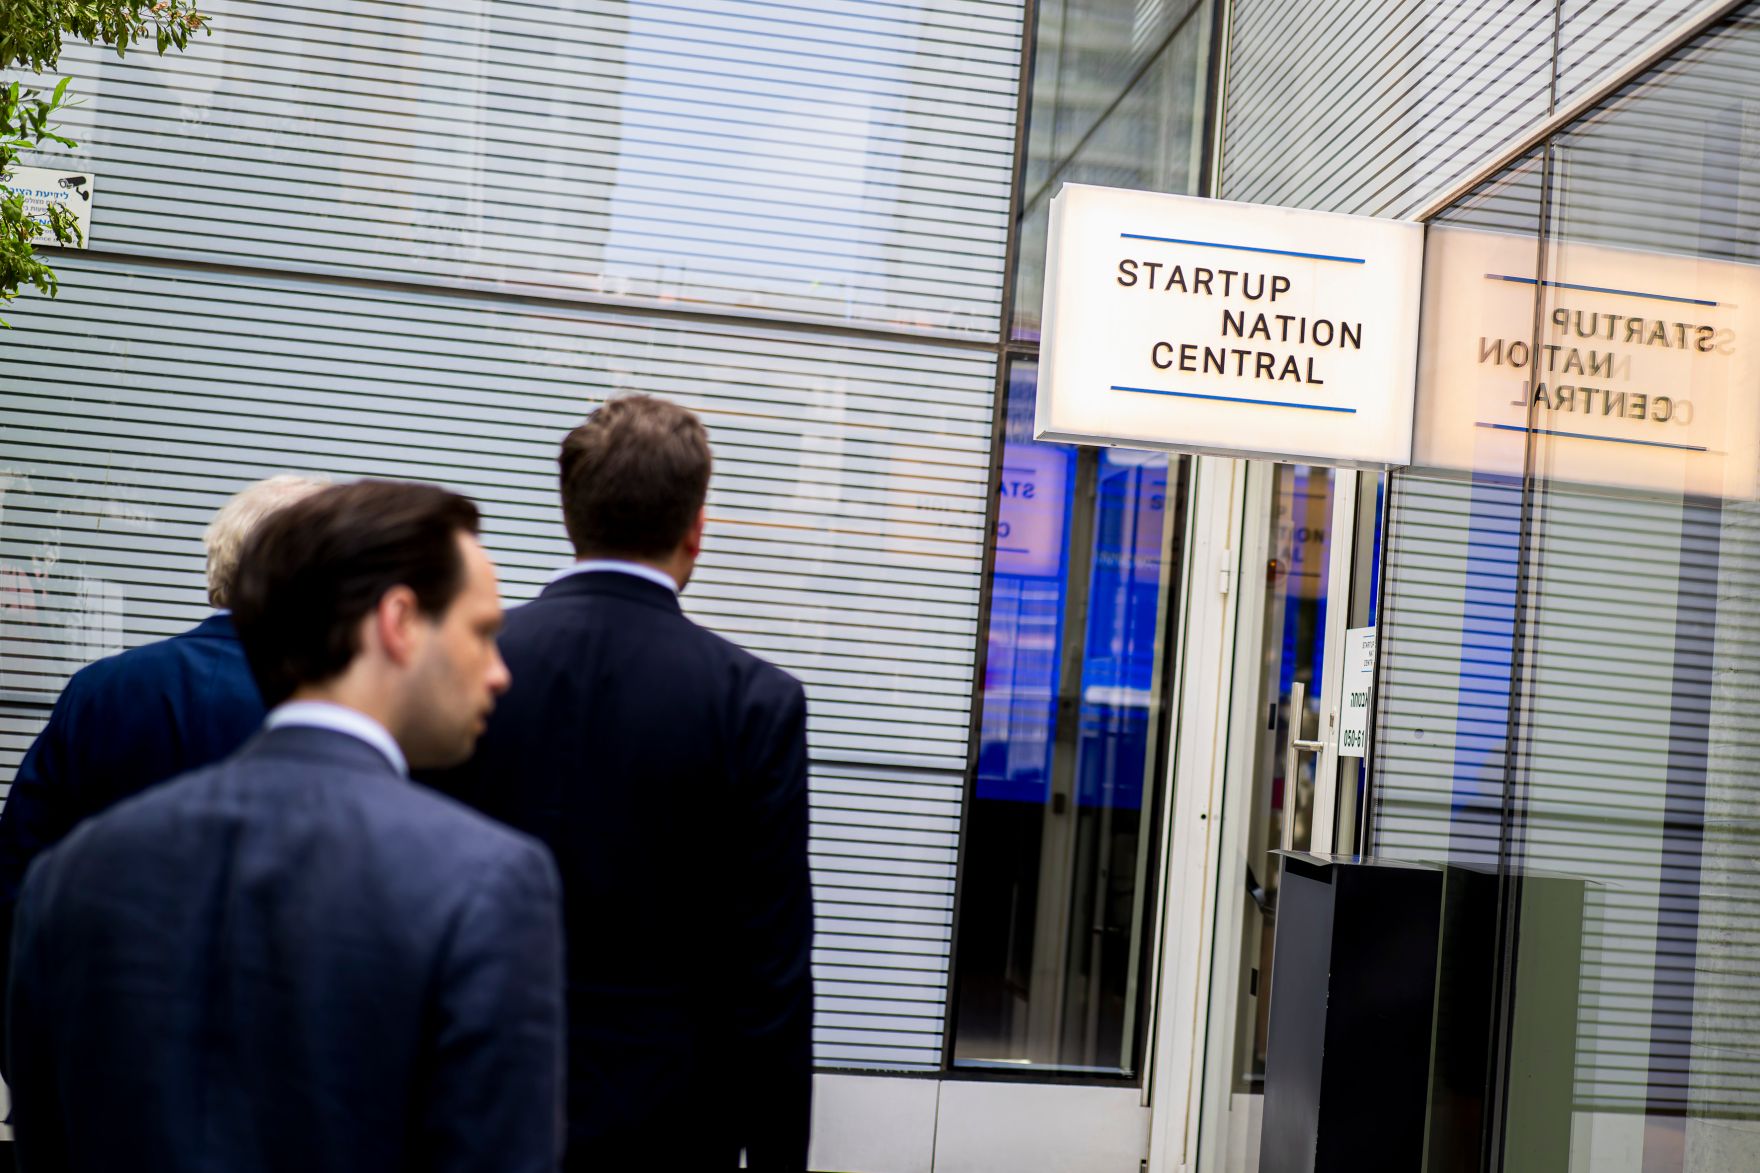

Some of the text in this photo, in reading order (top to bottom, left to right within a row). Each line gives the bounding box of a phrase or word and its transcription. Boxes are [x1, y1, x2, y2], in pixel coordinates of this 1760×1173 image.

[36, 190, 69, 200] לידיעת
[1117, 259, 1291, 302] STARTUP
[1222, 309, 1362, 350] NATION
[1152, 341, 1324, 385] CENTRAL
